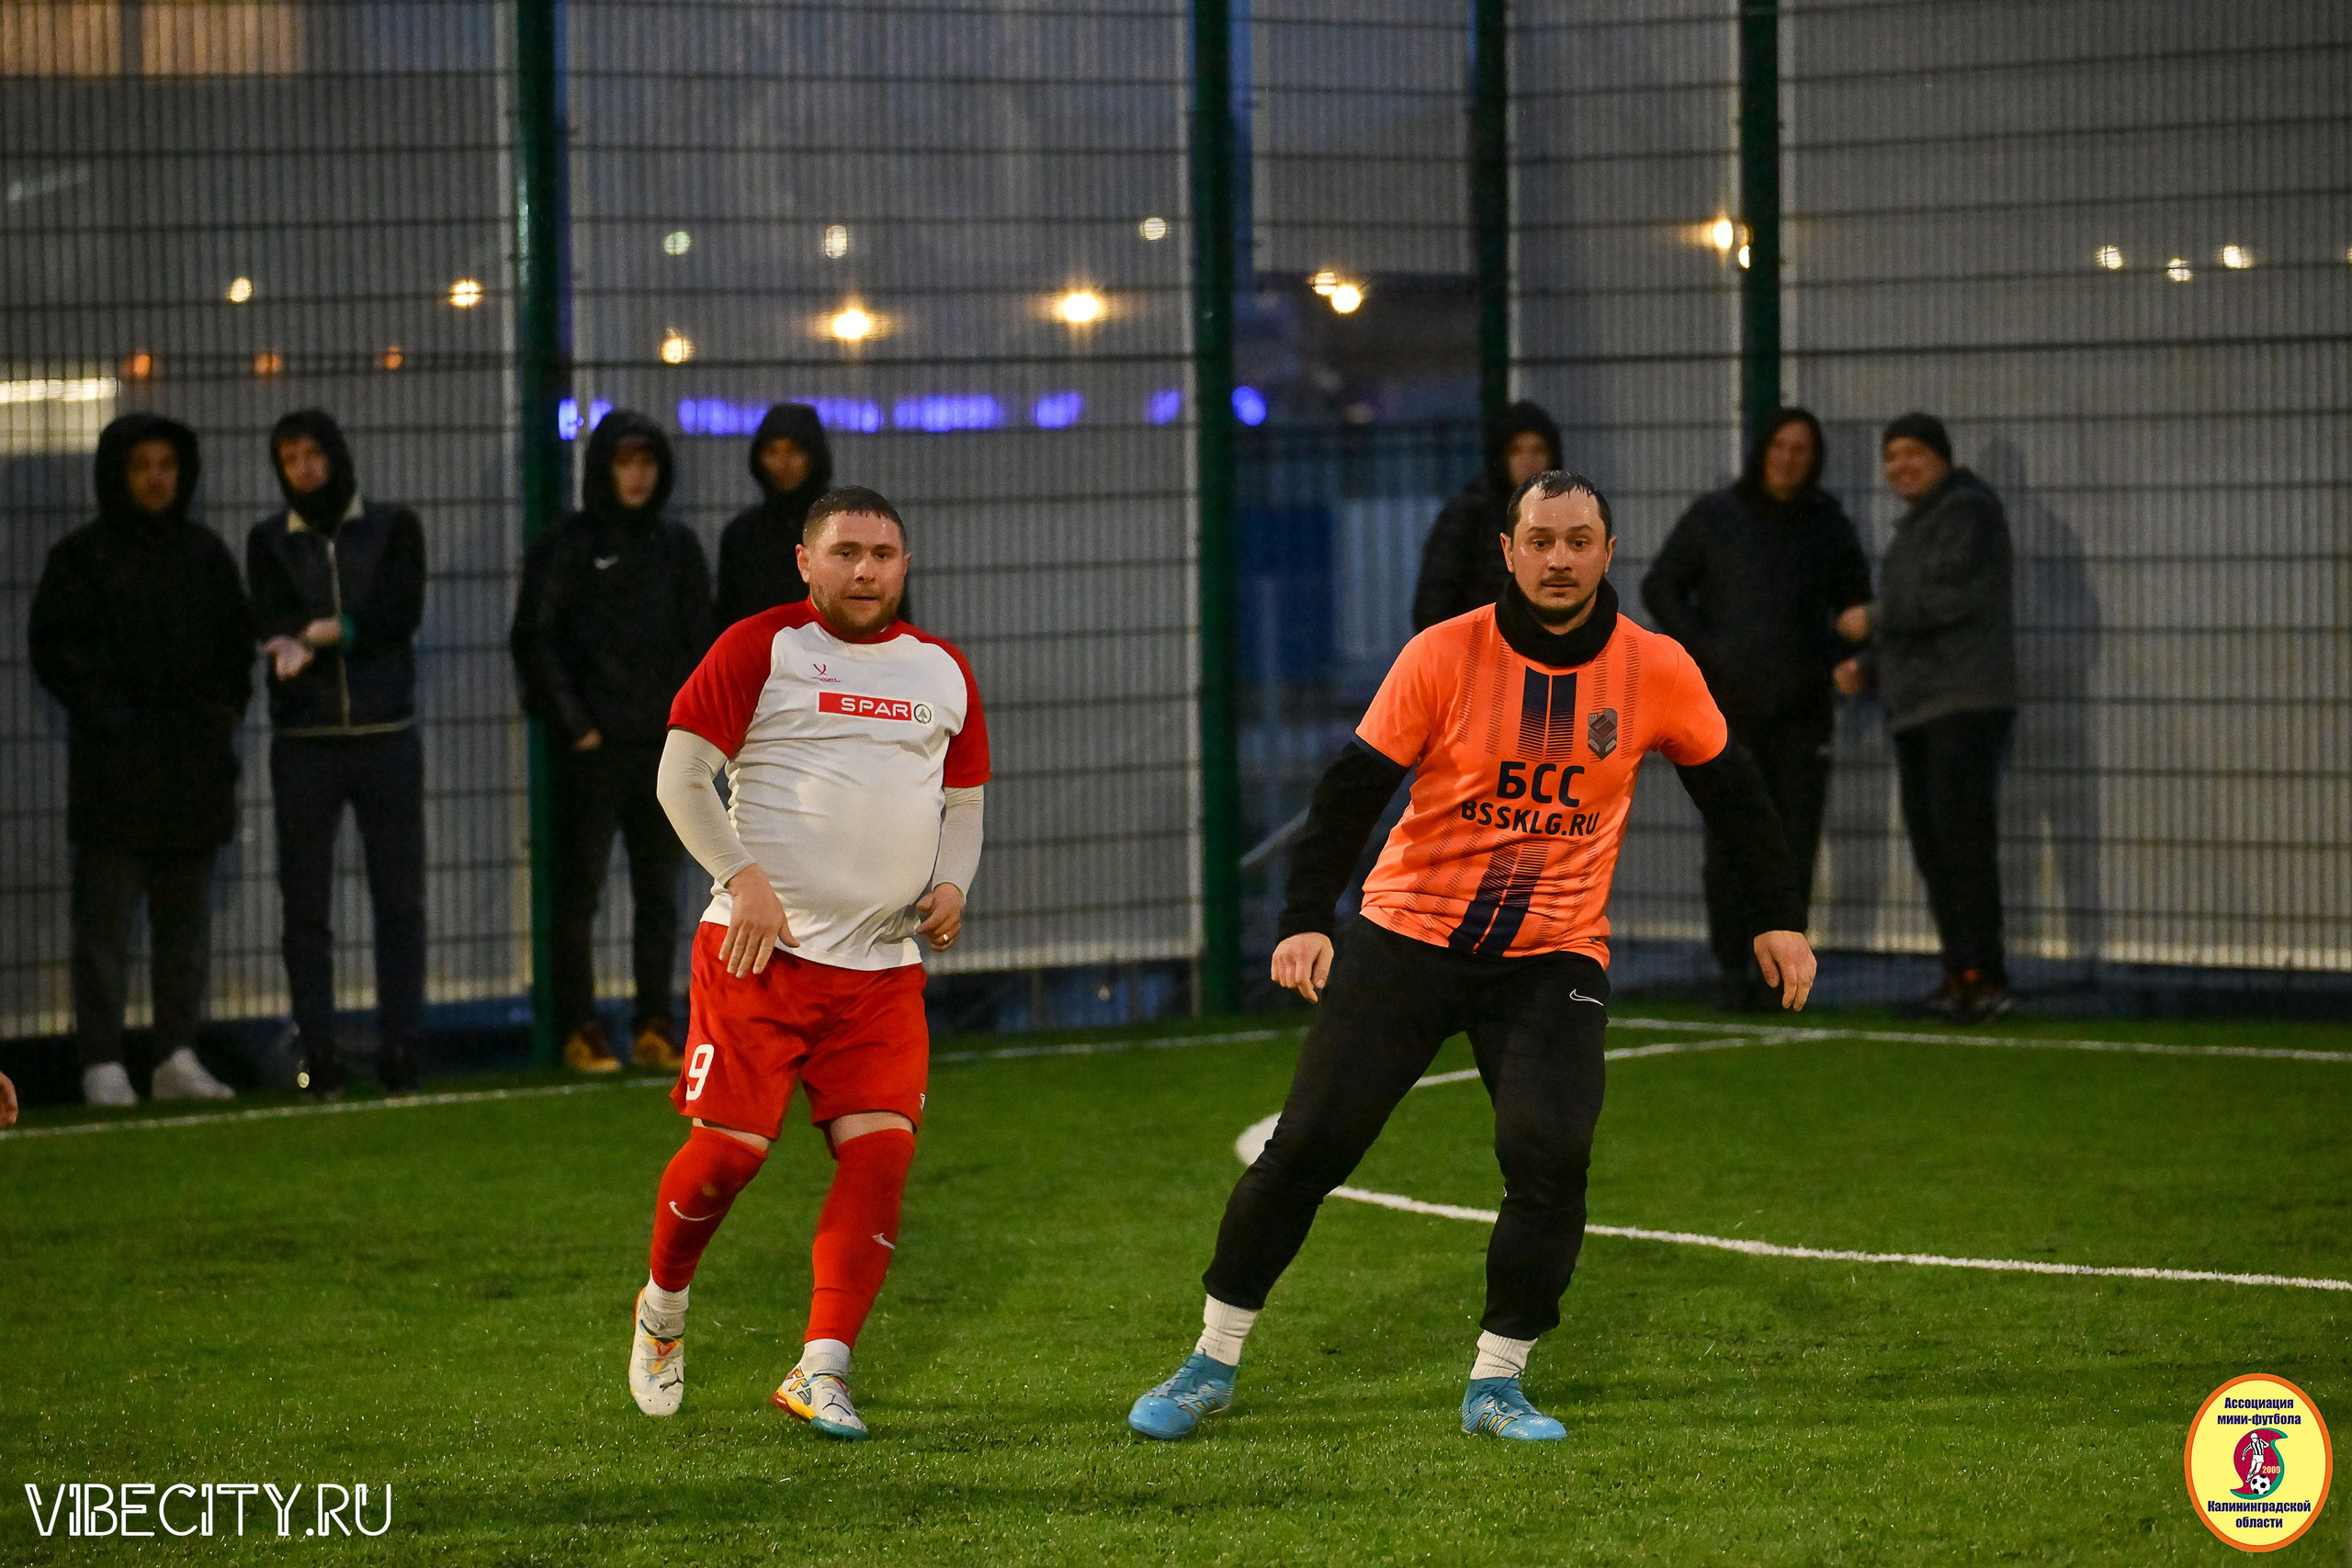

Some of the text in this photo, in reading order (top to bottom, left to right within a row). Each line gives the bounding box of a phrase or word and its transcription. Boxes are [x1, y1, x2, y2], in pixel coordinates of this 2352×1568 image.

[841, 697, 909, 717] SPAR
[1497, 761, 1585, 807] БСС
[1462, 799, 1600, 836] BSSKLG.RU
[686, 1044, 714, 1100] 9
